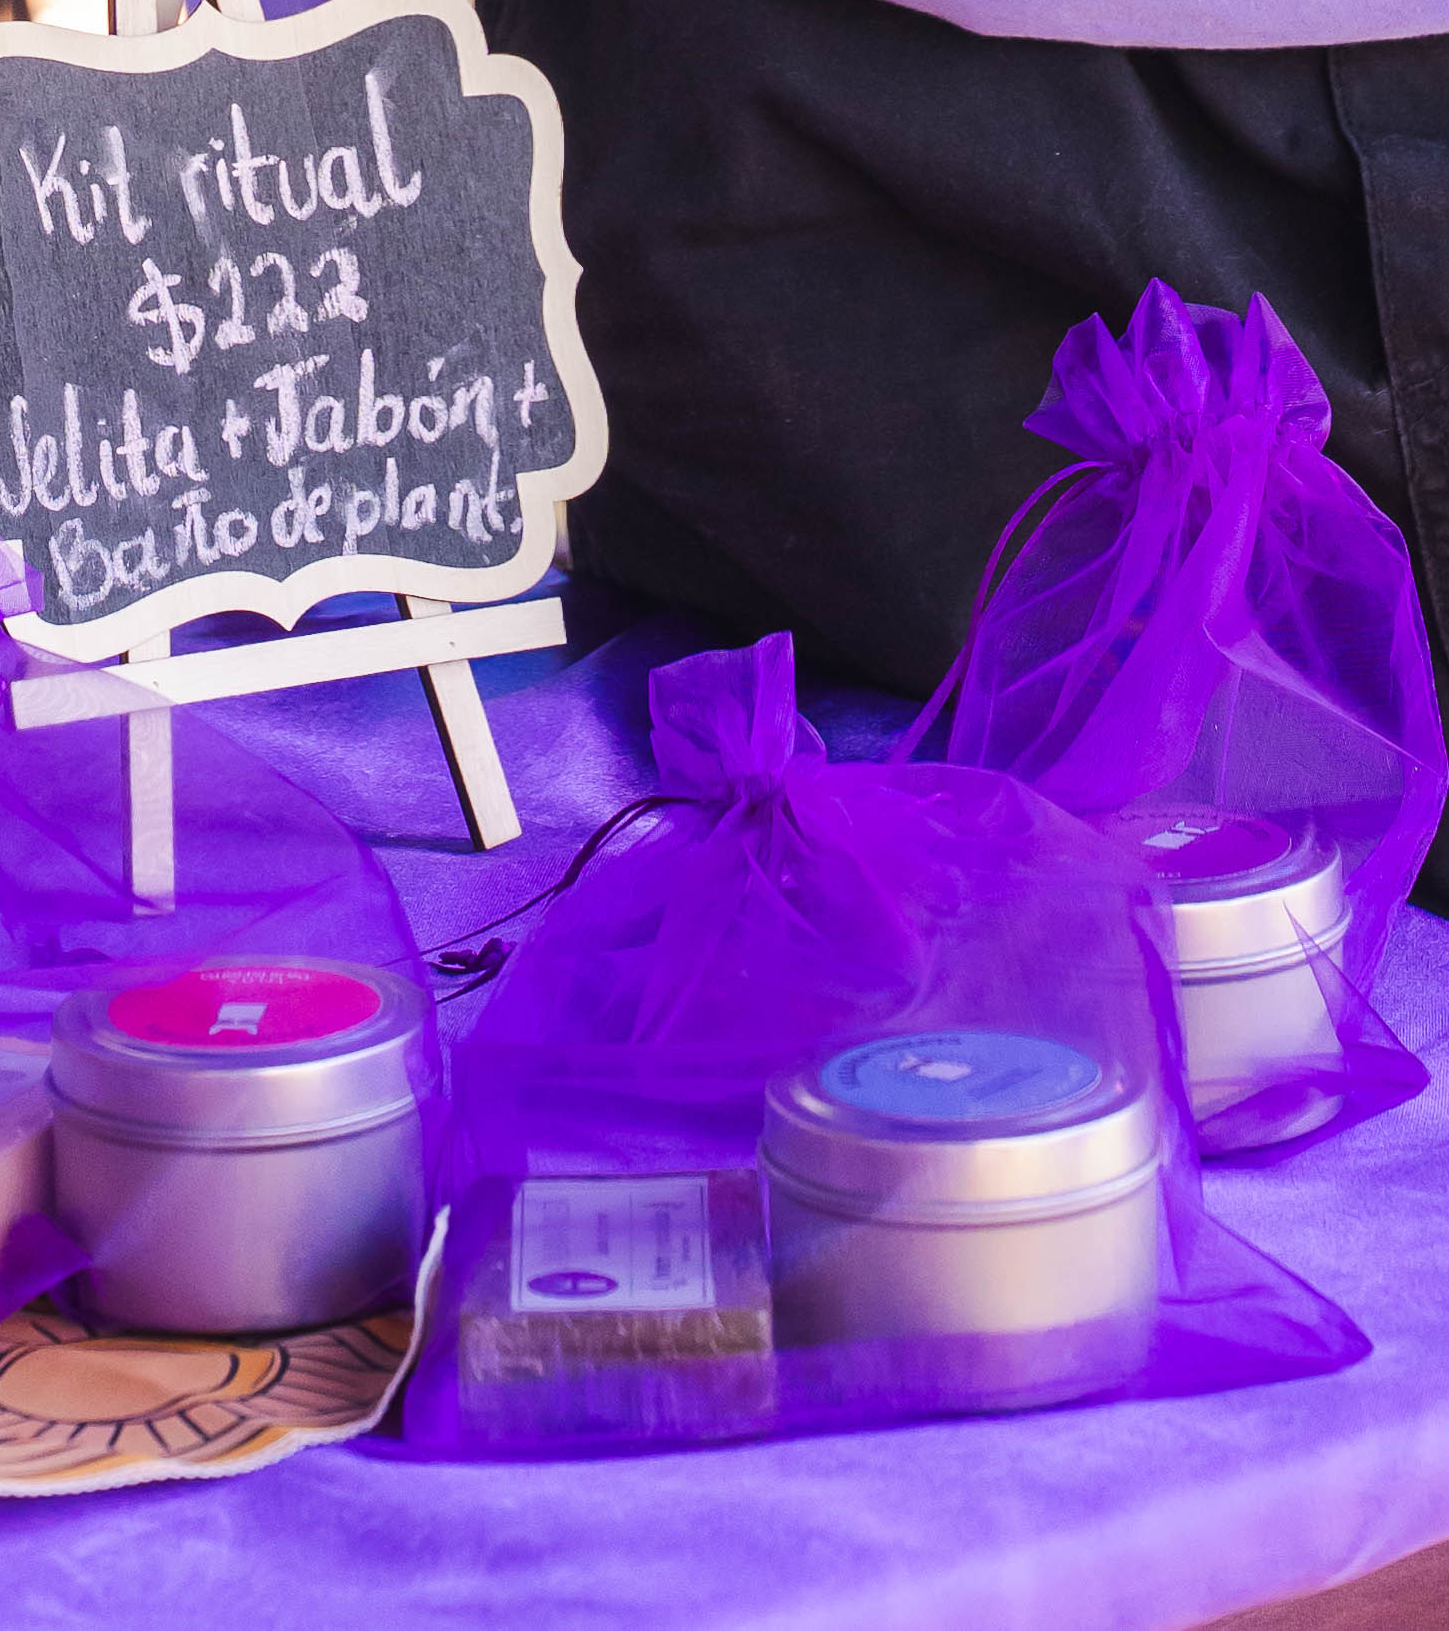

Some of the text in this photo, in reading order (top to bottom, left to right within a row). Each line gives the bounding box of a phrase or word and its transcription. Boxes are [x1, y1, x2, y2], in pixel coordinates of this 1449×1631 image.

[19, 72, 422, 245] Kit ritual
[127, 247, 369, 375] $222
[254, 348, 500, 467] Jabón
[49, 487, 259, 610] Baño
[270, 466, 333, 549] de
